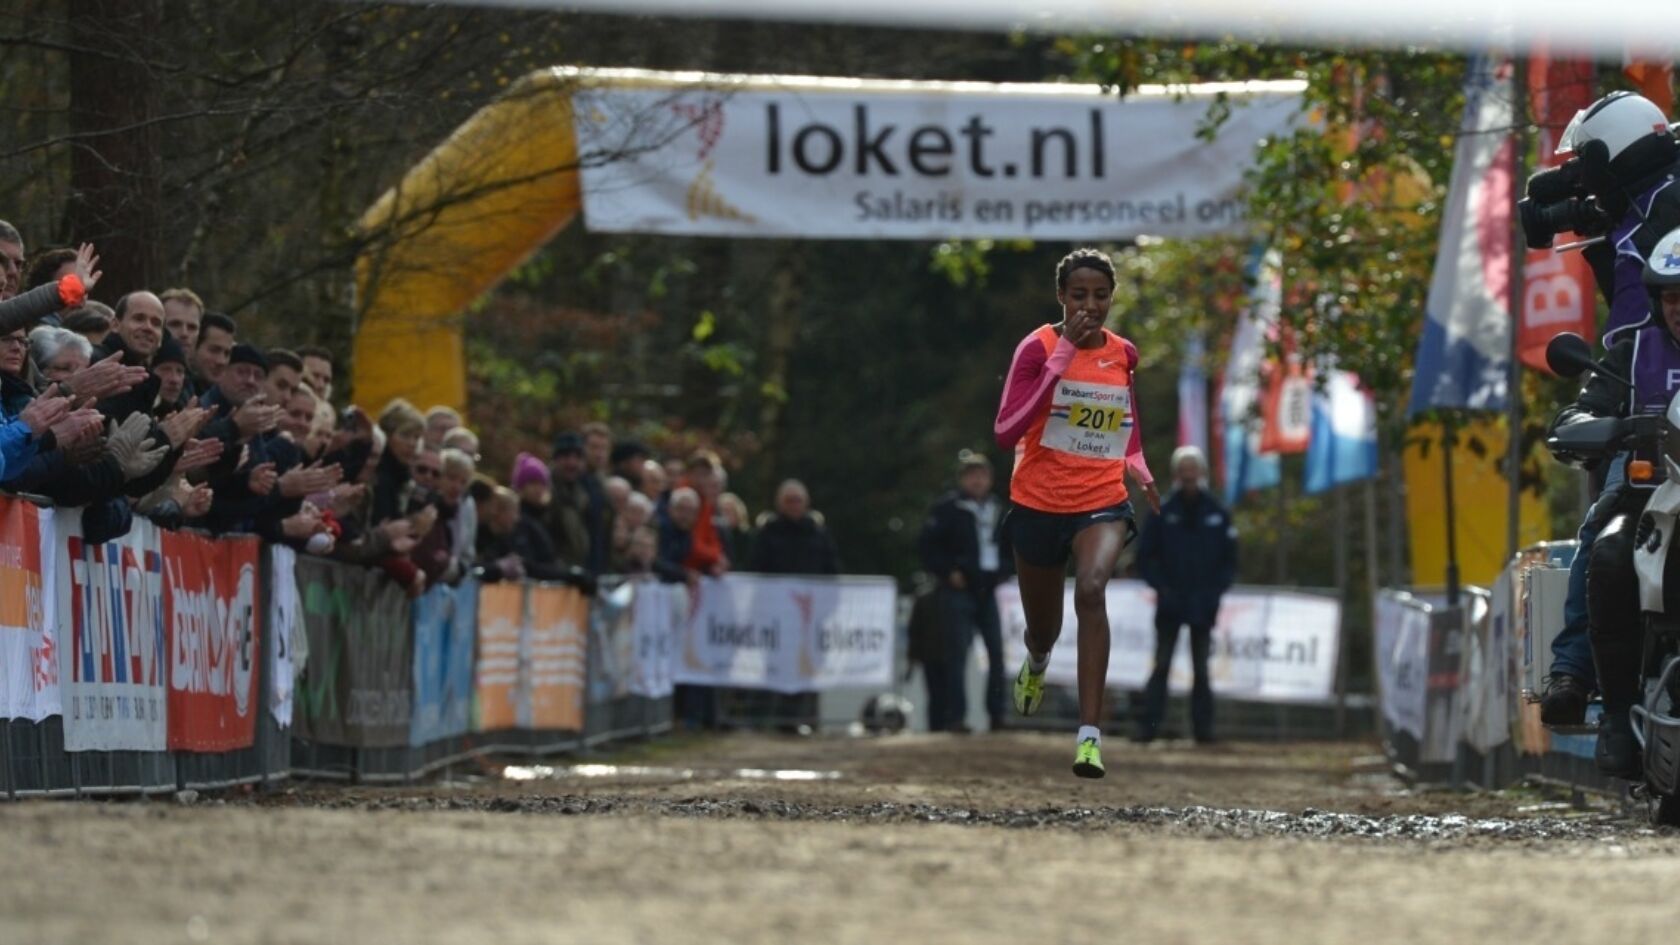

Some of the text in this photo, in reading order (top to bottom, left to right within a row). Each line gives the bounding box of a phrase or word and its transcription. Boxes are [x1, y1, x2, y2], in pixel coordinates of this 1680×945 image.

[766, 102, 1104, 178] loket.nl
[854, 190, 963, 221] Salaris
[974, 199, 1015, 221] en
[1024, 193, 1187, 229] personeel
[1076, 407, 1115, 431] 201
